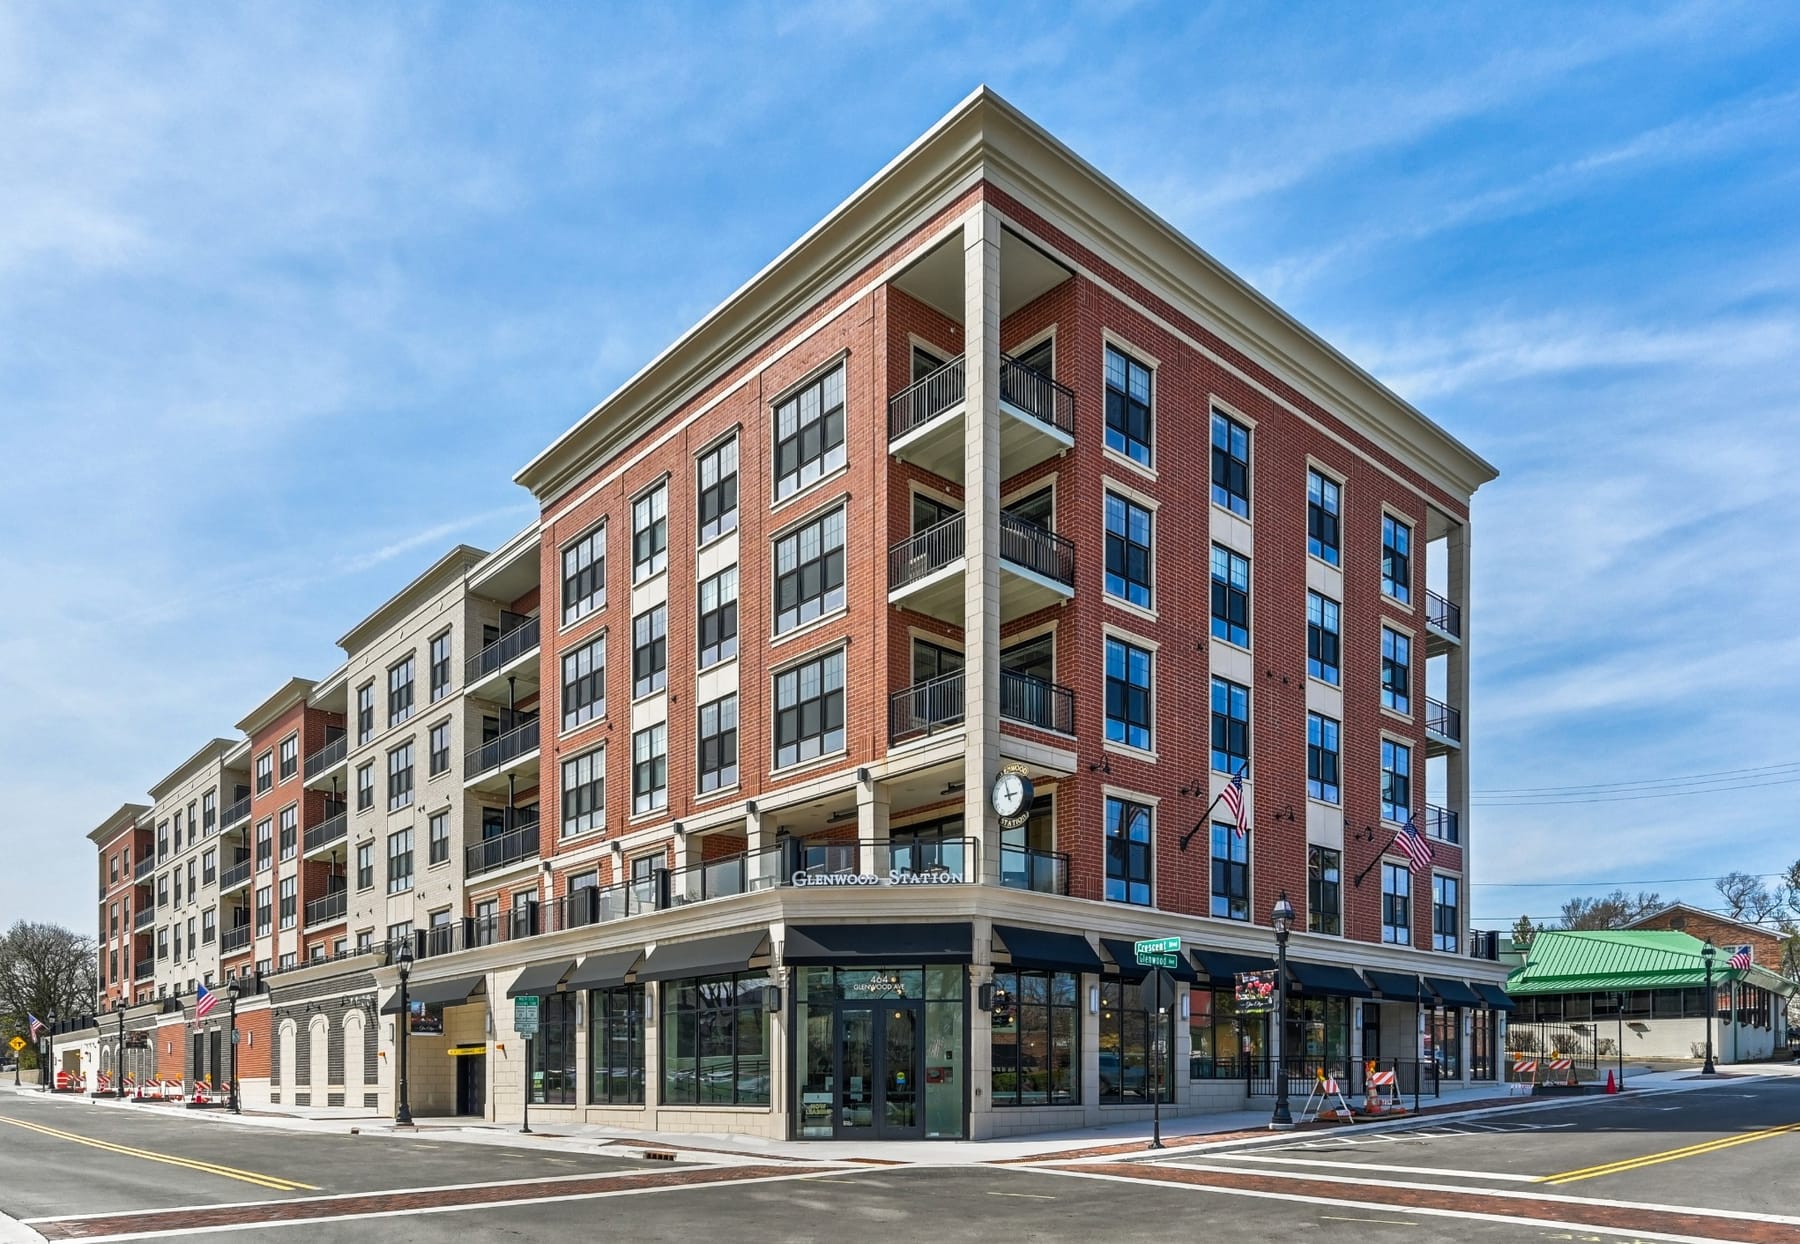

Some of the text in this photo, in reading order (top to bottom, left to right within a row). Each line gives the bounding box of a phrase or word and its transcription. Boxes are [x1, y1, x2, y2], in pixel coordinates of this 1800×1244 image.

[792, 869, 963, 887] GLENWOOD STATION
[1137, 941, 1167, 952] Crescent
[1139, 953, 1167, 966] Glenwood
[870, 975, 888, 984] 464
[853, 983, 893, 991] GLENWOOD
